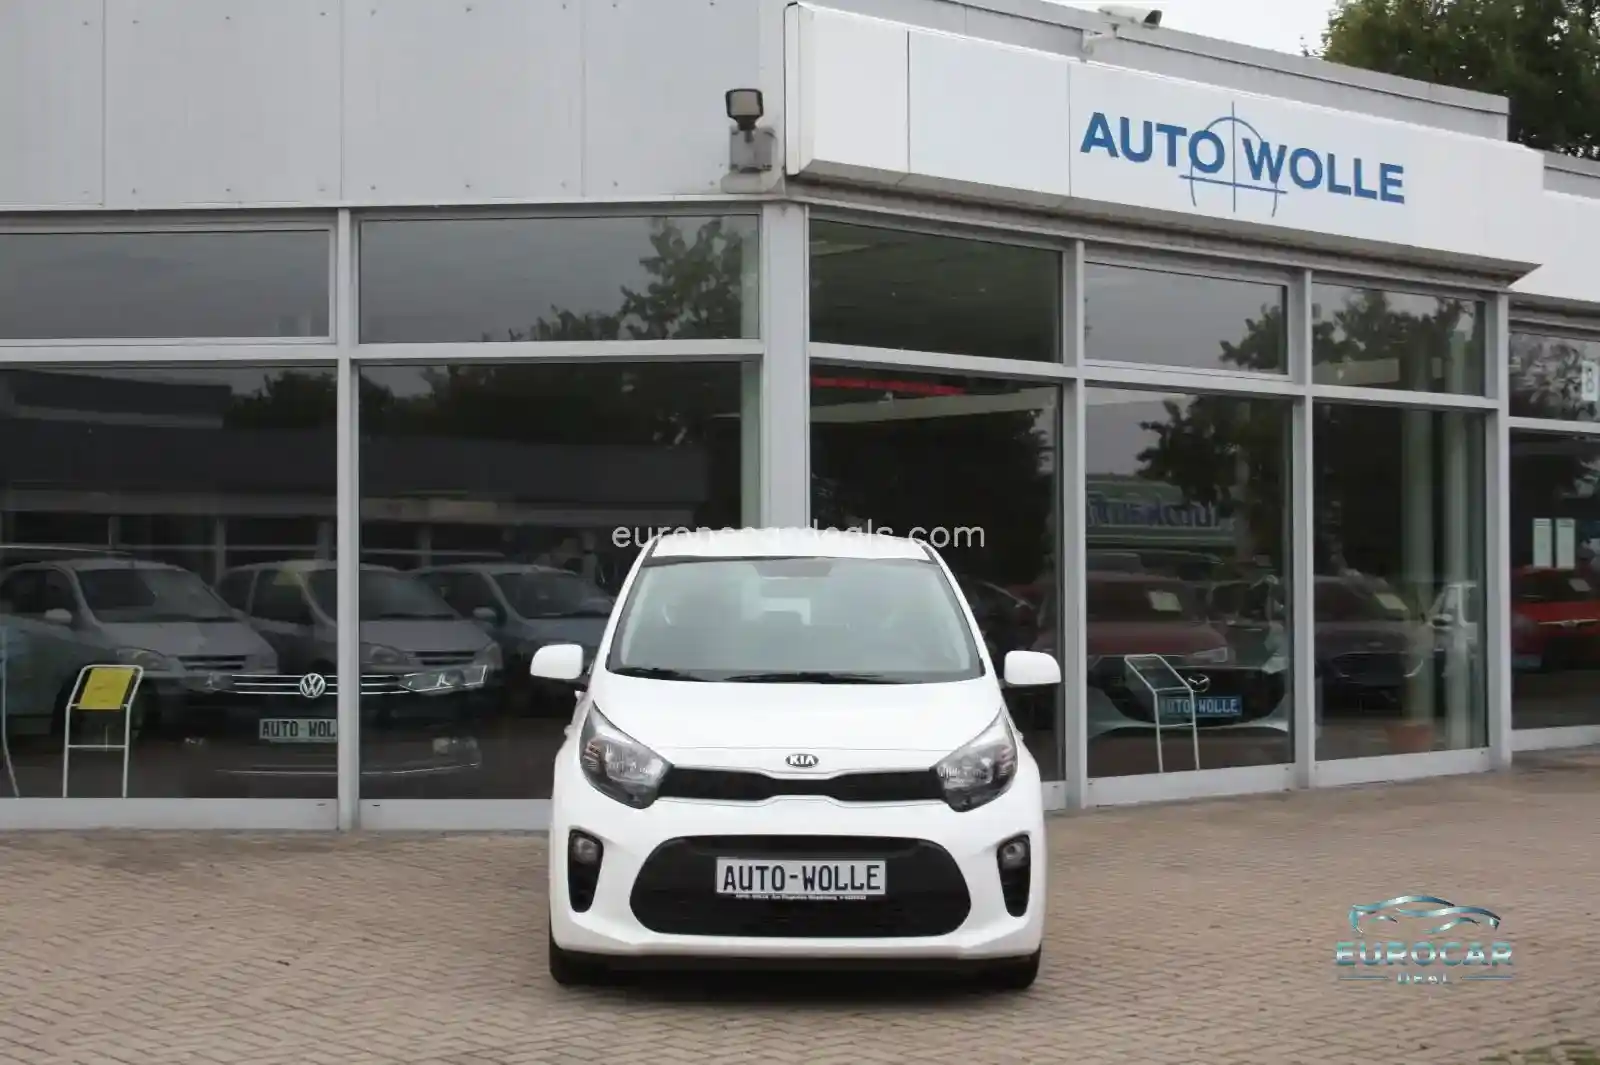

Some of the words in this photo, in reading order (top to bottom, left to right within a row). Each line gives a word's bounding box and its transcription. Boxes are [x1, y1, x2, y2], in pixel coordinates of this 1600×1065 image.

[1080, 111, 1226, 174] AUTO
[1242, 137, 1406, 205] WOLLE
[789, 754, 816, 766] KIA
[723, 864, 882, 892] AUTO-WOLLE
